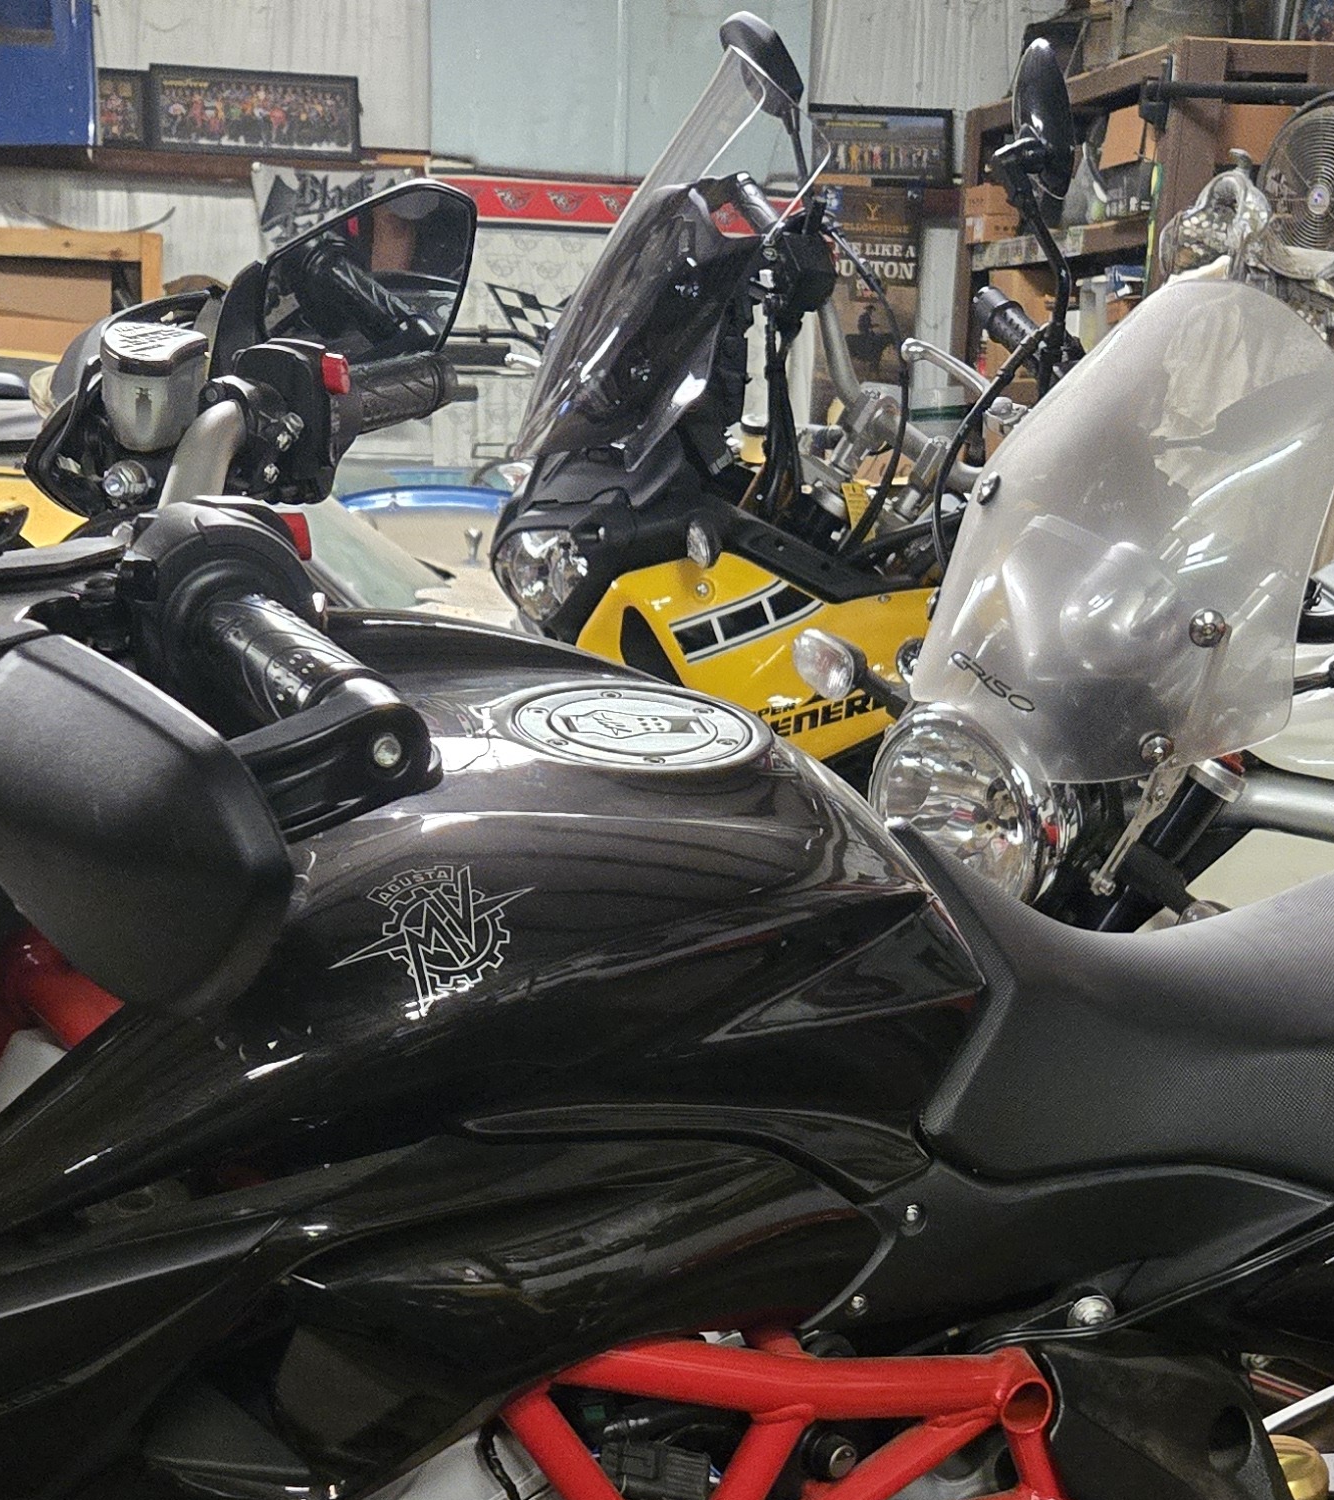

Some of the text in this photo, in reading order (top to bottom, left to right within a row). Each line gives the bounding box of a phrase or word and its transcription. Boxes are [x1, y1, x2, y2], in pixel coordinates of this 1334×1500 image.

[865, 243, 903, 257] LIKE
[905, 245, 916, 258] A
[835, 259, 916, 280] UTON
[378, 869, 449, 903] AGUSTA
